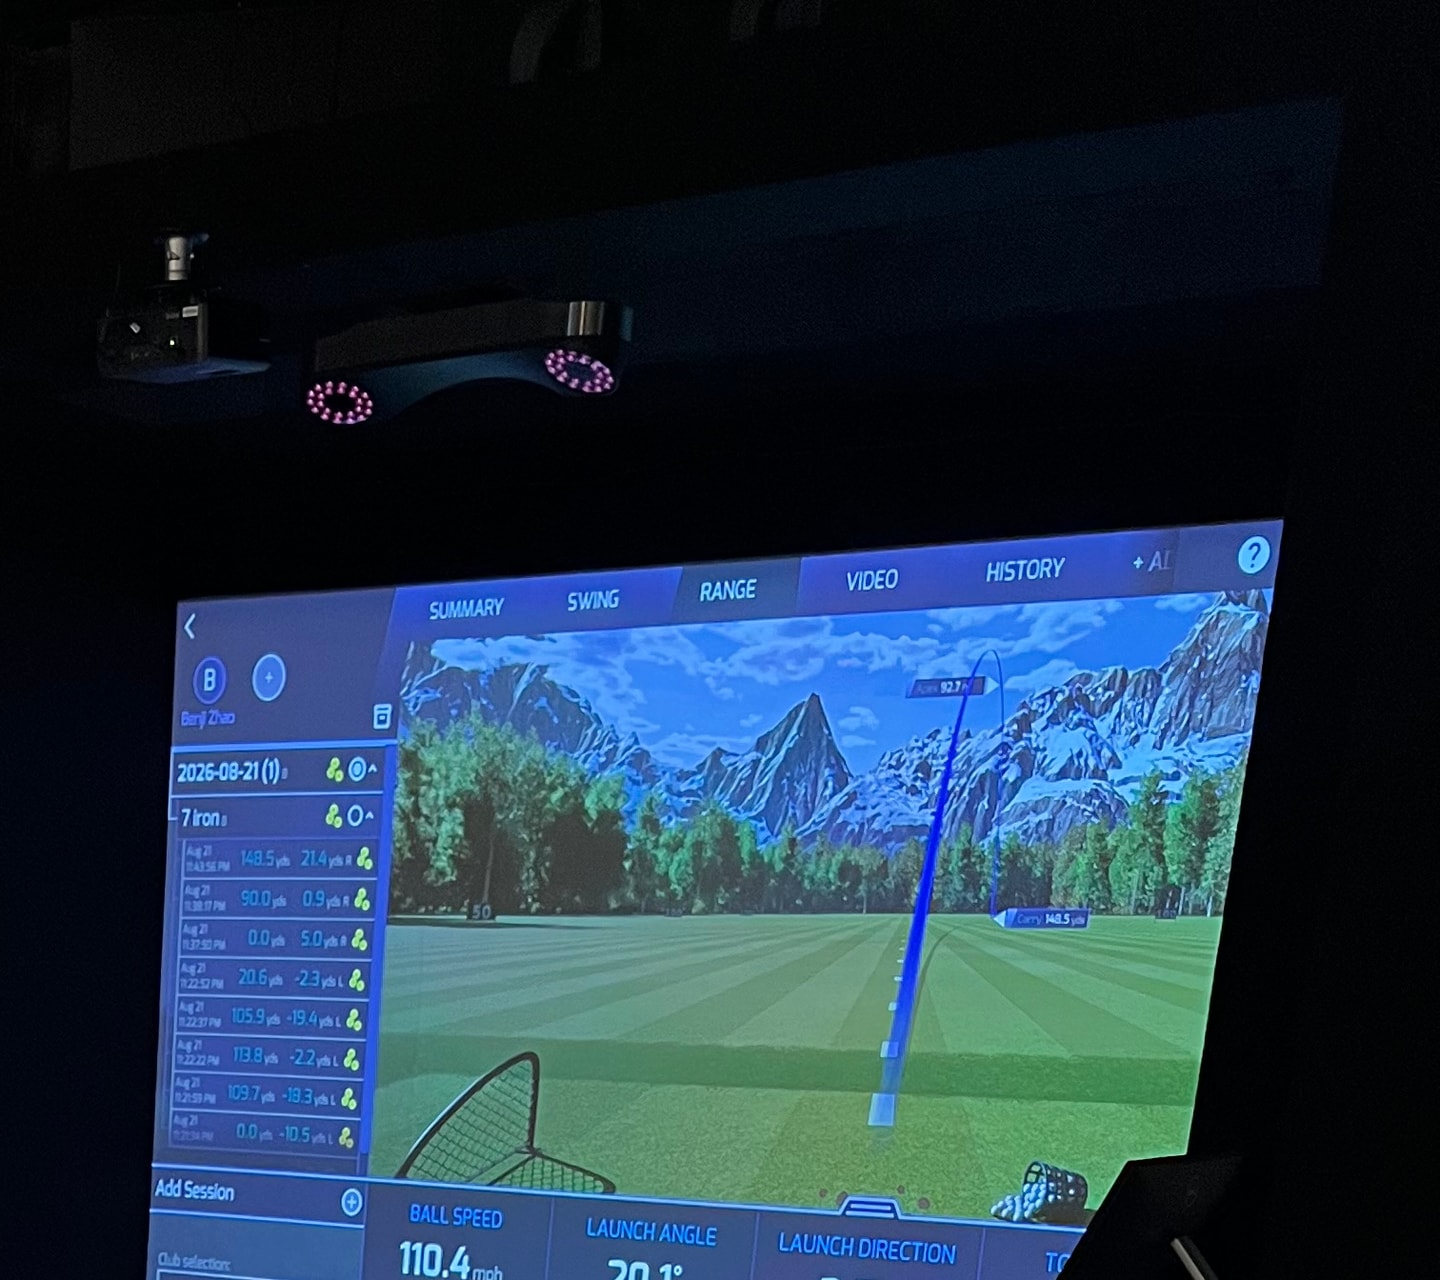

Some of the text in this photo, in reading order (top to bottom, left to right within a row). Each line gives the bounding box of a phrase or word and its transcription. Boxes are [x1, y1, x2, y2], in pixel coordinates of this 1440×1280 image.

[986, 557, 1066, 583] HISTORY
[700, 578, 757, 602] RANGE
[846, 569, 899, 592] VIDEO
[429, 597, 504, 620] SUMMARY
[567, 589, 620, 612] SWING
[202, 667, 216, 692] B
[177, 758, 280, 784] 2026-08-21 (1)
[181, 809, 191, 827] 7
[241, 850, 291, 869] 148.5 yds
[301, 850, 327, 867] 21.4
[328, 856, 344, 869] yds
[241, 890, 287, 910] 90.0 yds
[303, 890, 325, 907] 0.9
[326, 897, 342, 910] yds
[472, 905, 491, 919] 50
[248, 929, 286, 949] 0.0 yds
[301, 930, 323, 947] 5.0
[324, 936, 339, 949] yds
[239, 969, 283, 988] 20.6 yds
[295, 970, 320, 987] -2.3
[321, 975, 337, 989] yds
[232, 1008, 281, 1026] 105.9 yds
[286, 1009, 317, 1026] -19.4
[318, 1015, 334, 1029] yds
[234, 1047, 279, 1066] 113.8 yds
[290, 1049, 316, 1066] -2.2
[316, 1055, 332, 1069] yds
[228, 1084, 260, 1101] 109.7
[236, 1123, 258, 1139] 0.0
[279, 1126, 310, 1142] -10.5
[155, 1179, 235, 1202] Add Session
[409, 1204, 503, 1230] BALL SPEED
[586, 1217, 717, 1248] LAUNCH ANGLE
[778, 1232, 957, 1265] LAUNCH DIRECTION
[399, 1240, 471, 1280] 110.4
